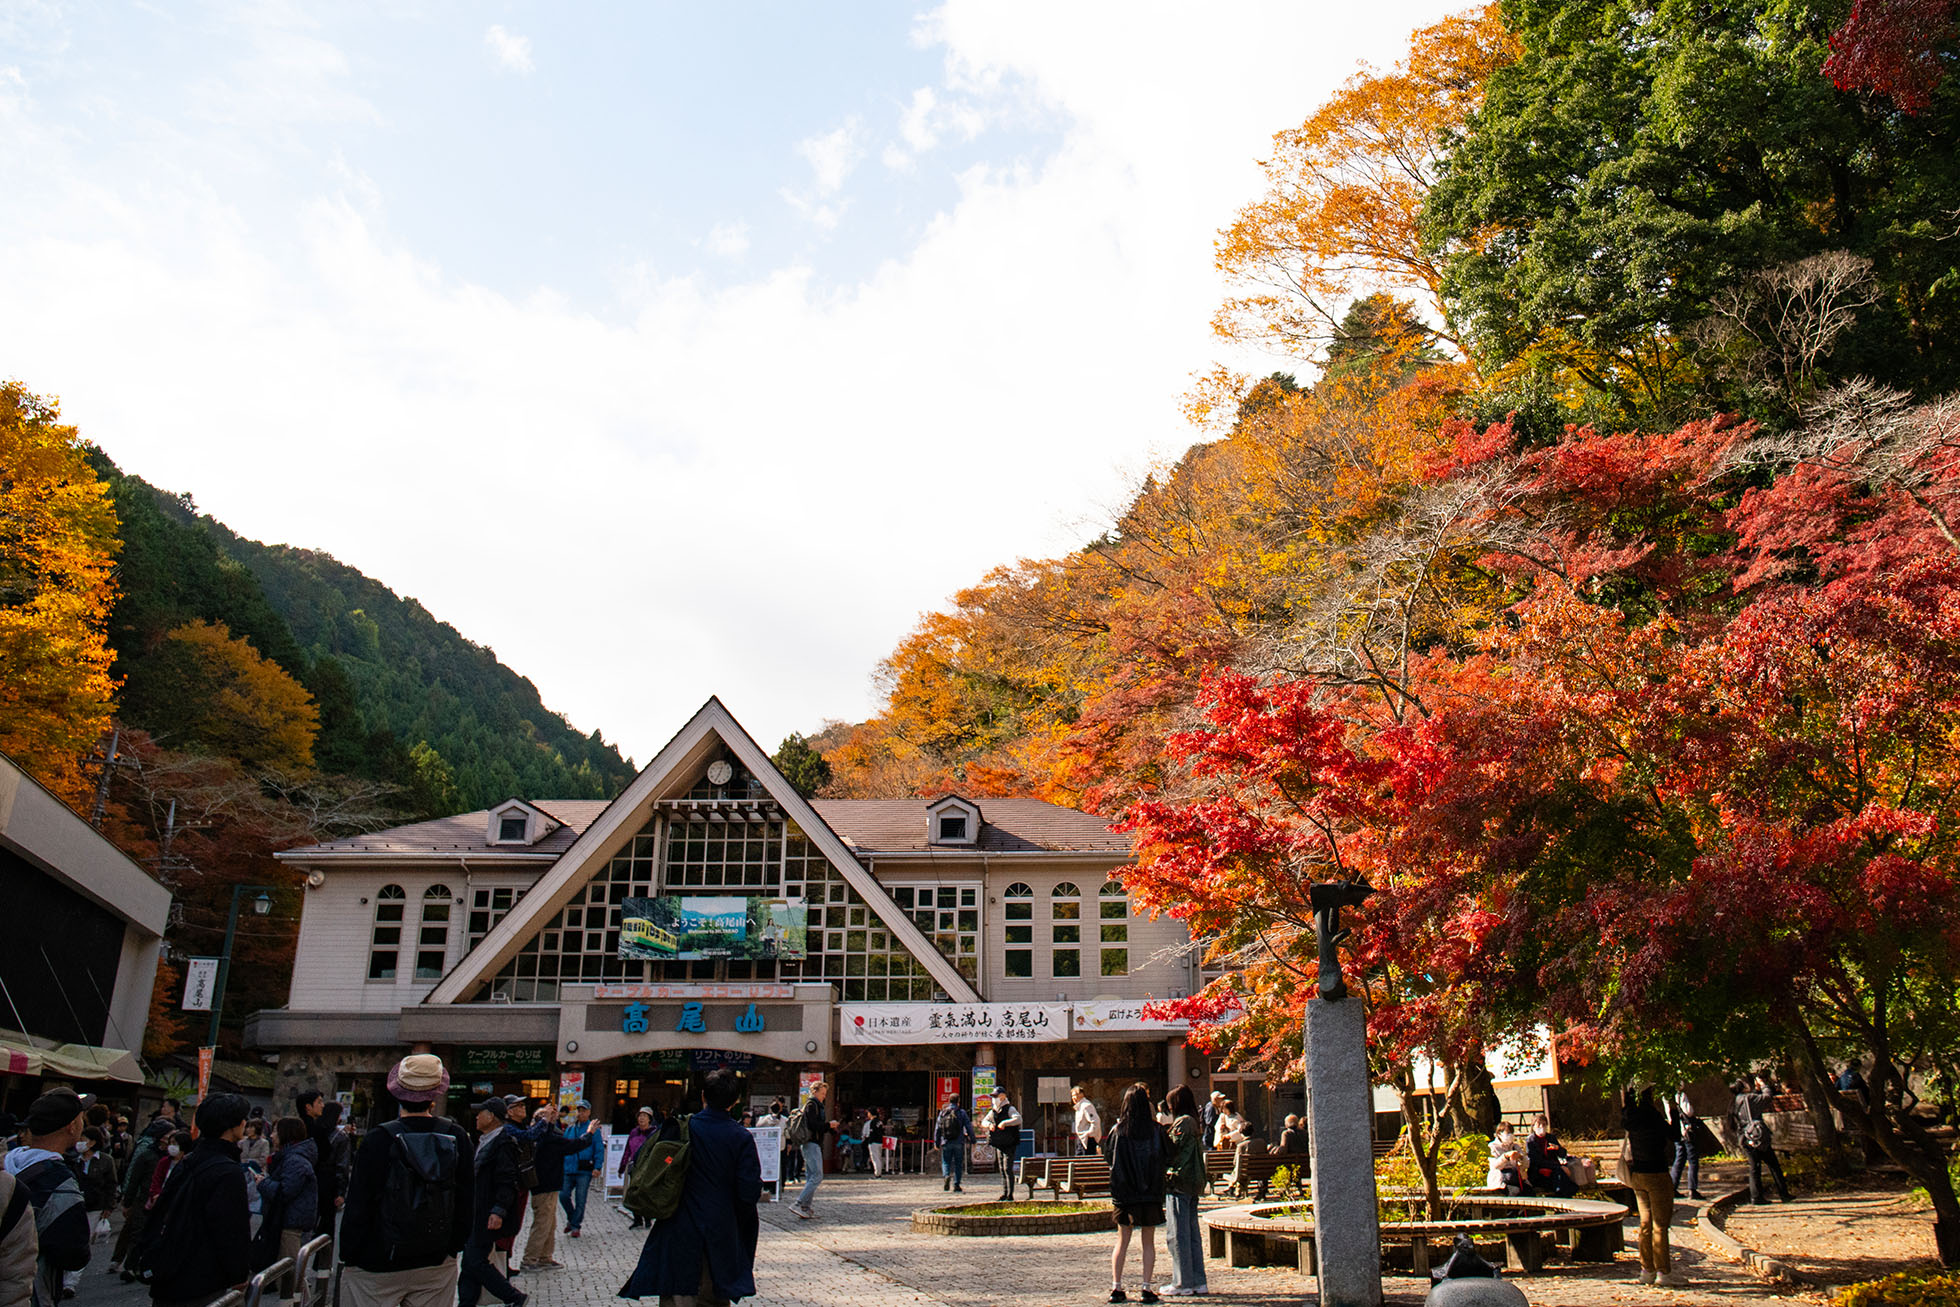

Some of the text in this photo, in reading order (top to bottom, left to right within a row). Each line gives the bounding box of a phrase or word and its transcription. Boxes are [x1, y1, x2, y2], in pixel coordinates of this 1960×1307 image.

[596, 986, 789, 998] ケーブルカー エコーリフト
[623, 1001, 764, 1033] 高尾山
[869, 1016, 912, 1028] 日本遺産
[1000, 1010, 1048, 1028] 高尾山
